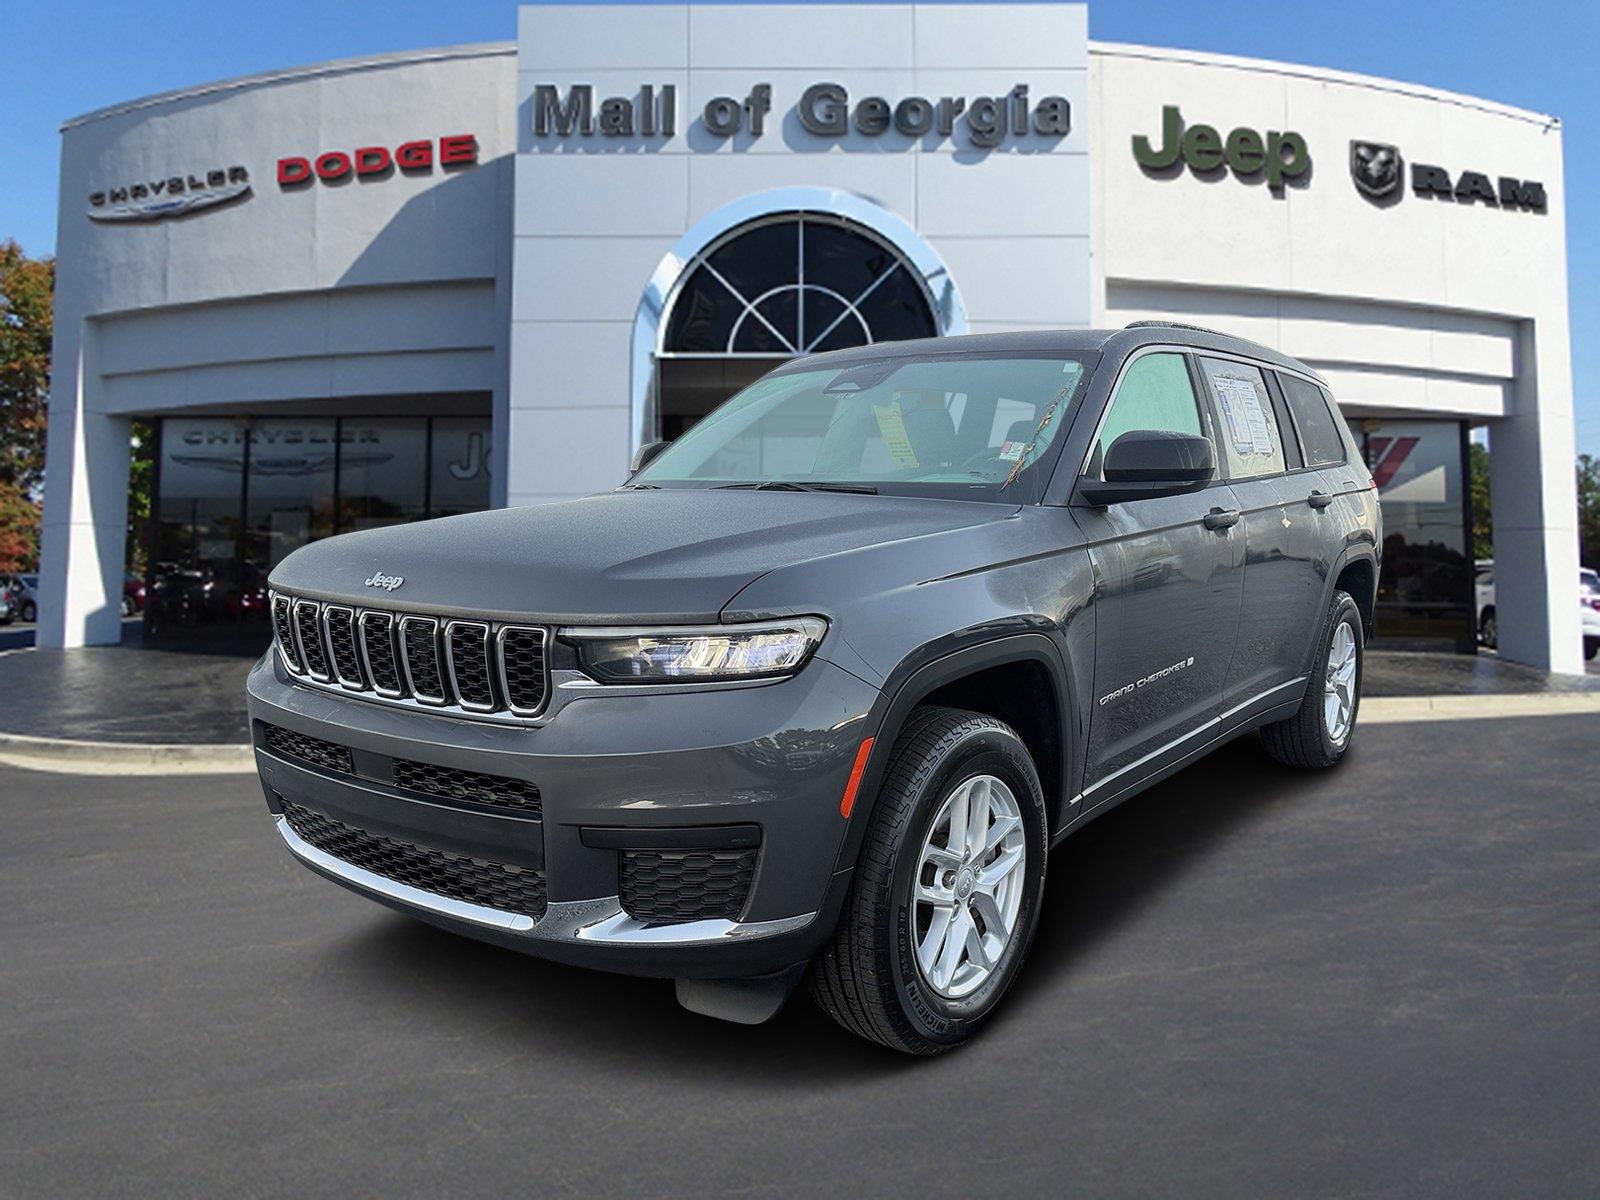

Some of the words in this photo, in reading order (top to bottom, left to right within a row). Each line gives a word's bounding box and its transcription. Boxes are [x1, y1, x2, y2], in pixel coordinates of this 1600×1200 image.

[533, 84, 676, 138] Mall
[705, 84, 773, 137] of
[799, 83, 1072, 147] Georgia
[277, 134, 477, 187] DODGE
[1131, 104, 1310, 189] Jeep
[89, 165, 249, 207] CHRYSLER
[1411, 163, 1548, 213] RAM
[183, 430, 380, 444] CHRYSLER
[364, 571, 404, 592] Jeep
[1099, 683, 1135, 706] GRAND
[1136, 660, 1187, 688] CHEROKEE
[906, 983, 949, 1033] MICHELIN
